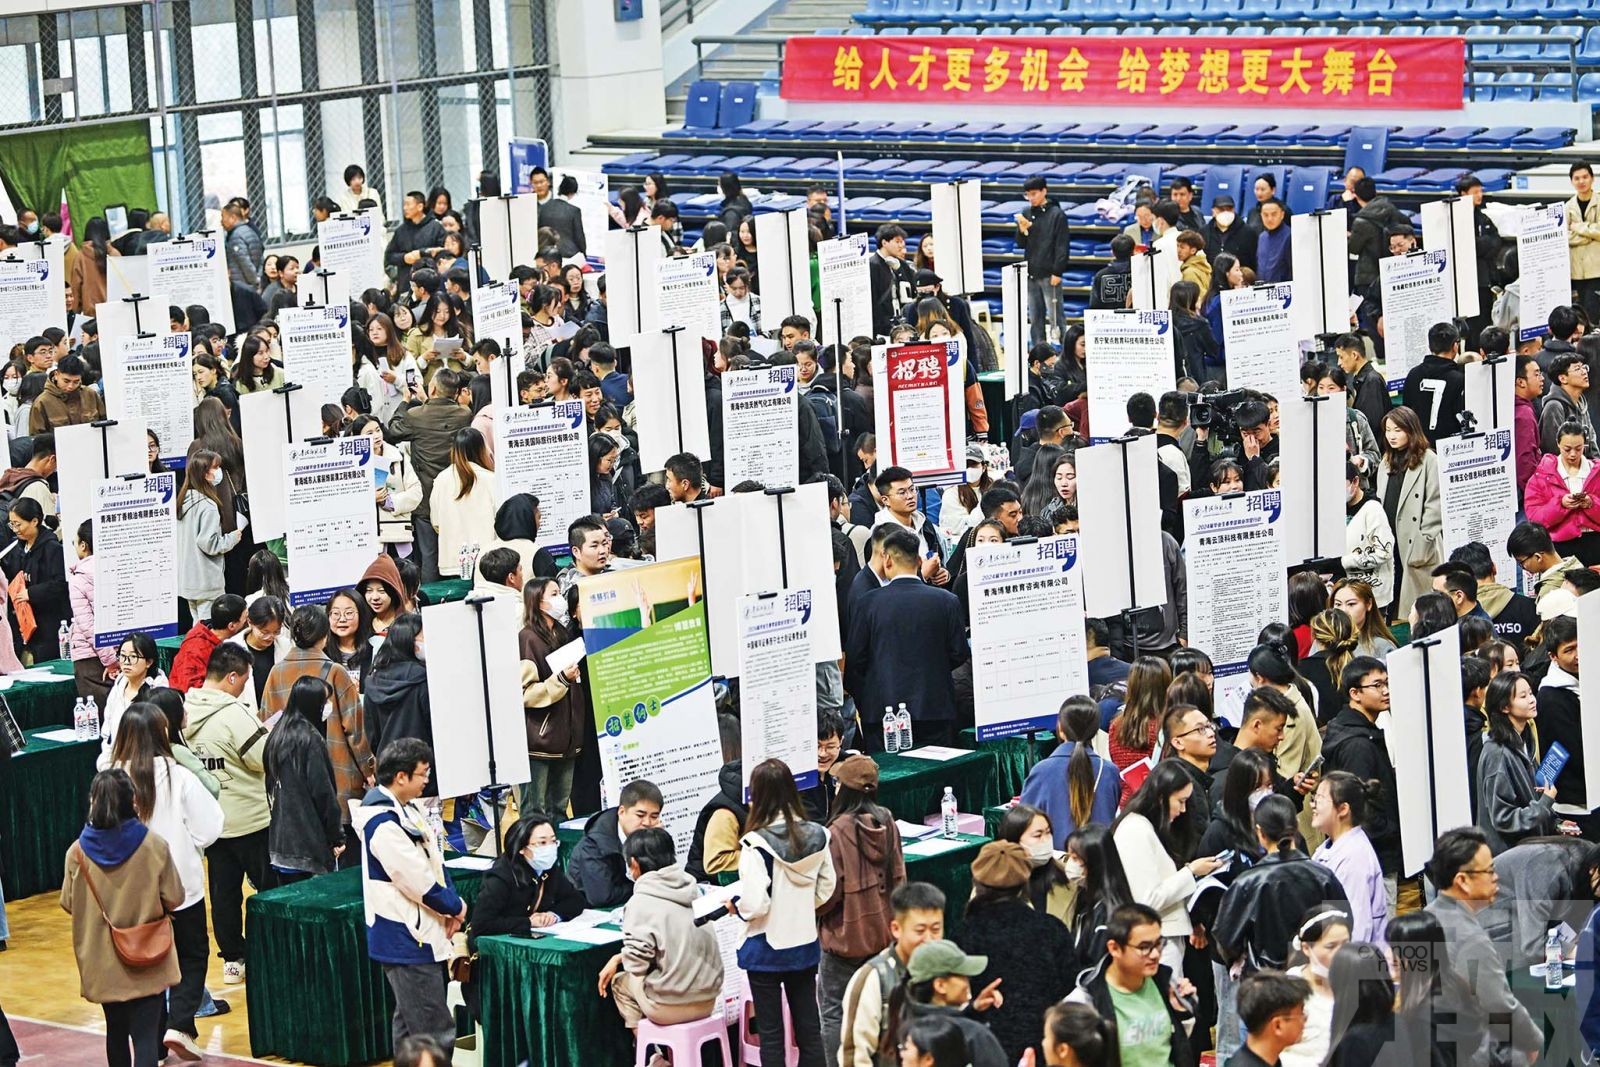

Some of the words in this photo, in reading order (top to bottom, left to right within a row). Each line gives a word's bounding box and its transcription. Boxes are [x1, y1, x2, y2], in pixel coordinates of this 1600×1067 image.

[832, 46, 1090, 92] 给人才更多机会
[1116, 47, 1397, 96] 给梦想更大舞台
[1423, 250, 1447, 265] 招聘
[1267, 285, 1292, 300] 招聘
[323, 306, 348, 320] 招聘
[1138, 310, 1168, 325] 招聘
[163, 334, 188, 348] 招聘
[768, 366, 794, 384] 招聘
[892, 354, 942, 381] 招聘
[552, 402, 582, 419] 招聘
[1420, 378, 1447, 430] 7
[339, 438, 370, 456] 招聘
[1484, 430, 1511, 450] 招聘
[144, 474, 172, 492] 招聘
[1246, 490, 1281, 512] 招聘
[1037, 538, 1077, 560] 招聘
[984, 576, 1068, 597] 青海博慧教育咨询有限公司
[784, 589, 812, 612] 招聘
